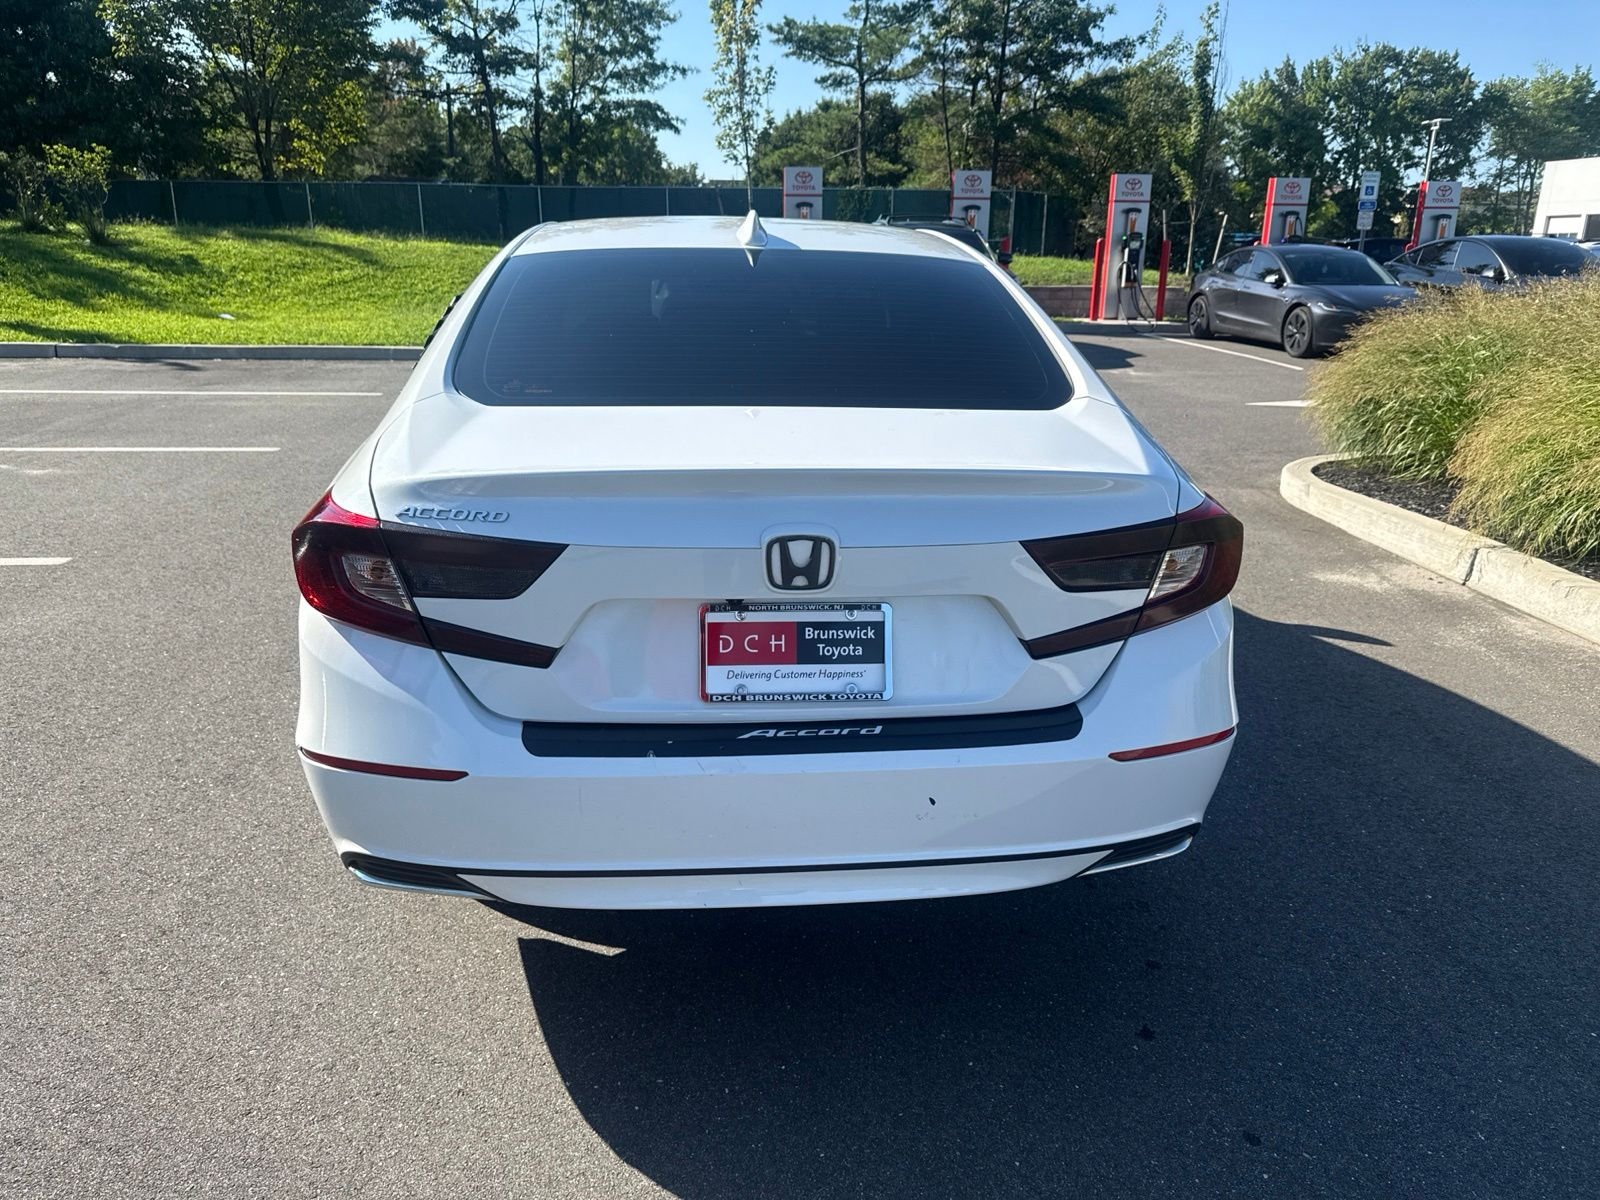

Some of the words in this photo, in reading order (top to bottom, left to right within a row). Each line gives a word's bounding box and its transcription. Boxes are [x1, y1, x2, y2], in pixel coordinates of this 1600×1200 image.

[395, 506, 510, 523] ACCORD
[805, 627, 875, 640] Brunswick
[817, 644, 863, 659] Toyota
[726, 669, 772, 681] Delivering
[774, 669, 816, 679] Customer
[737, 726, 883, 739] Accord
